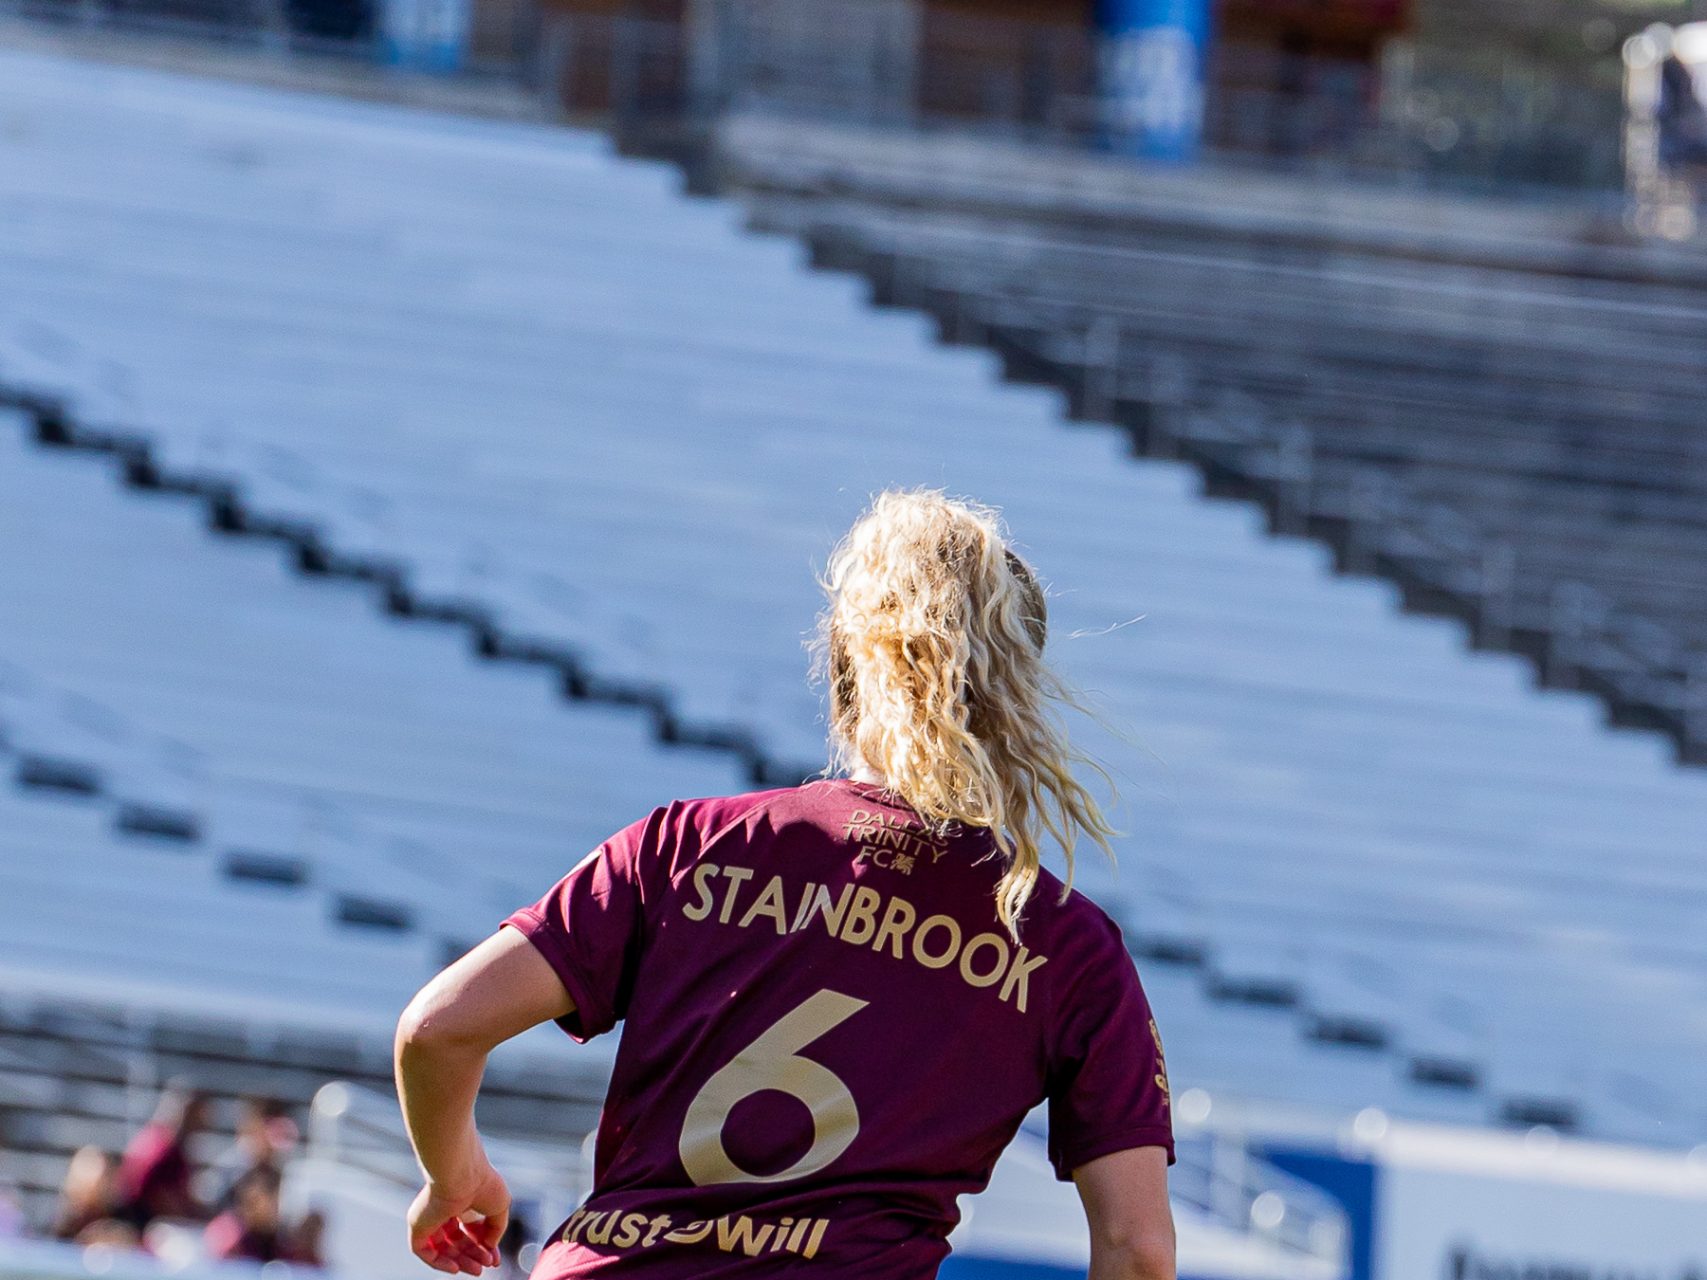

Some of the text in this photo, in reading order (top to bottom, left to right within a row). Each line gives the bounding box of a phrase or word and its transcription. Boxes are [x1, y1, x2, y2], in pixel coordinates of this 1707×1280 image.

[842, 823, 948, 864] TRINITY
[857, 845, 893, 868] FC
[682, 863, 1047, 1014] STAINBROOK
[679, 988, 870, 1186] 6
[562, 1205, 830, 1260] trust Will
